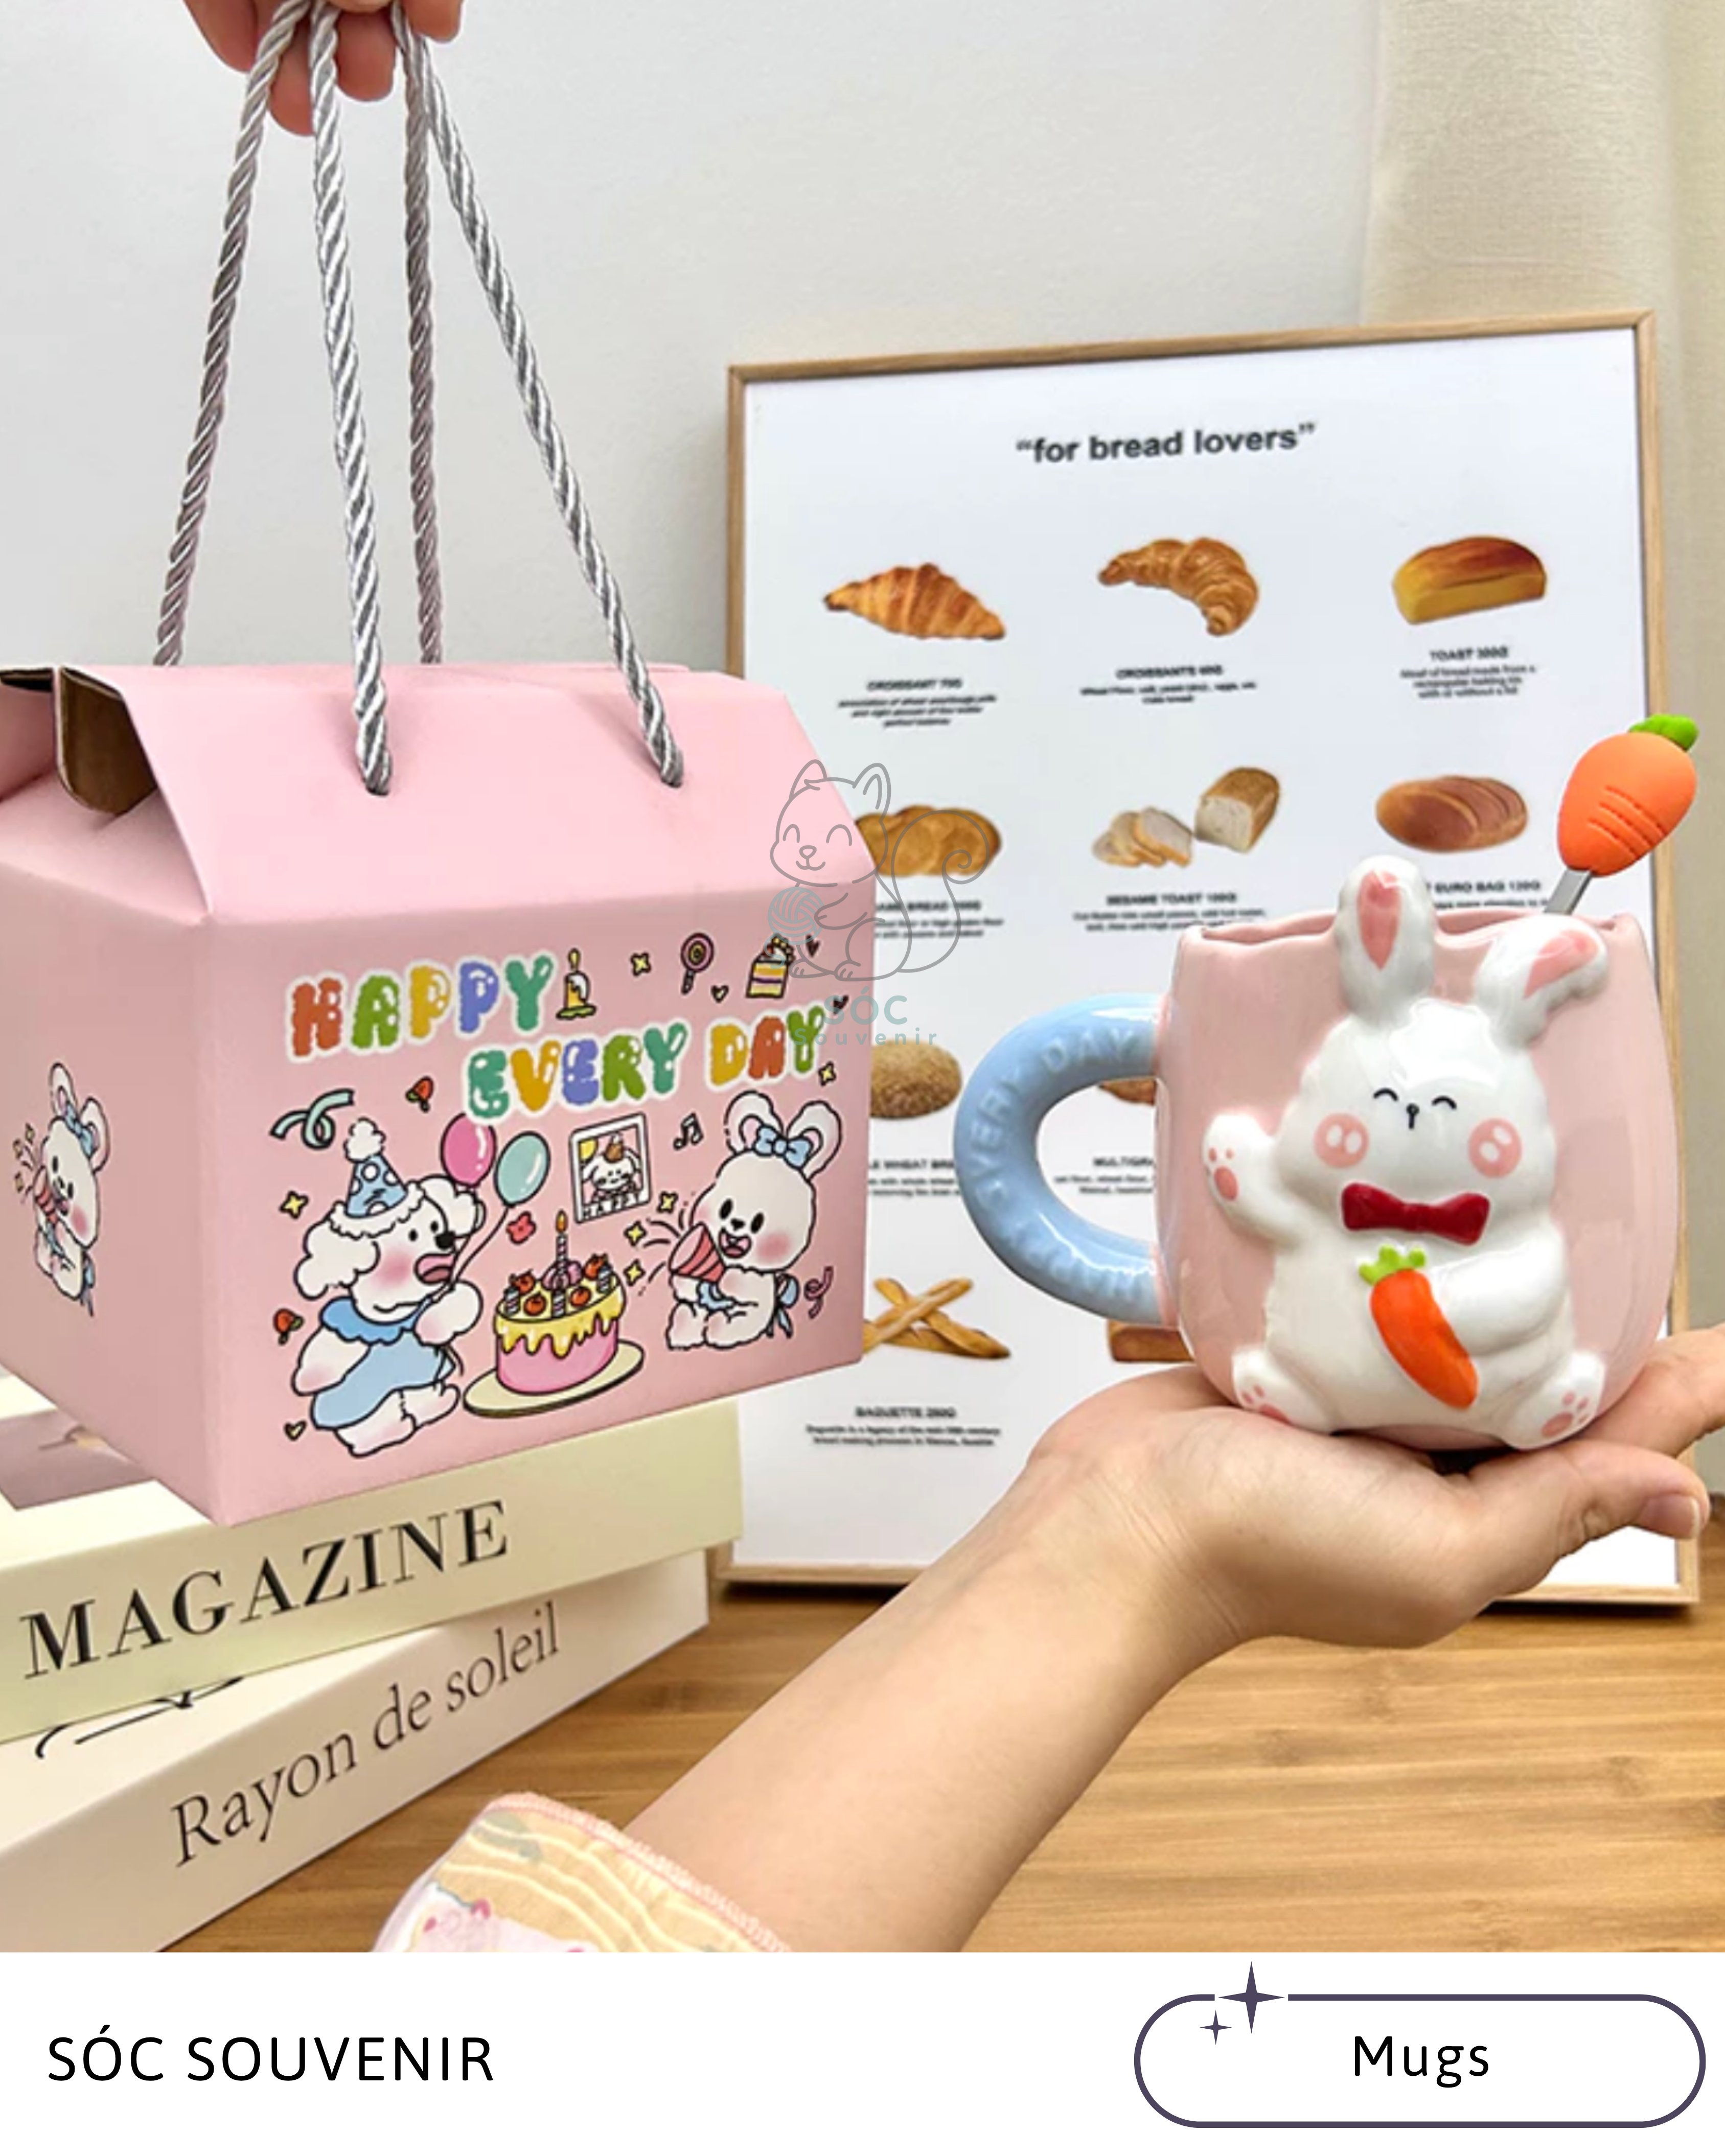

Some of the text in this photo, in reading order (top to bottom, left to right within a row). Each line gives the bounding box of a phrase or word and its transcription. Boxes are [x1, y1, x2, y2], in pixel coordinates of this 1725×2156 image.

[1089, 430, 1183, 460] bread
[1194, 422, 1317, 454] lovers”
[1430, 648, 1474, 661] TOAST
[1106, 895, 1158, 906] SESAME
[1161, 893, 1203, 905] TOAST
[1434, 883, 1472, 893] EURO
[1476, 882, 1505, 892] BAG
[292, 955, 553, 1058] HAPPY
[468, 1005, 824, 1119] EVERY DAY
[1040, 1026, 1135, 1072] DAY
[19, 1499, 508, 1680] MAGAZINE
[171, 1601, 560, 1868] Rayon de soleil
